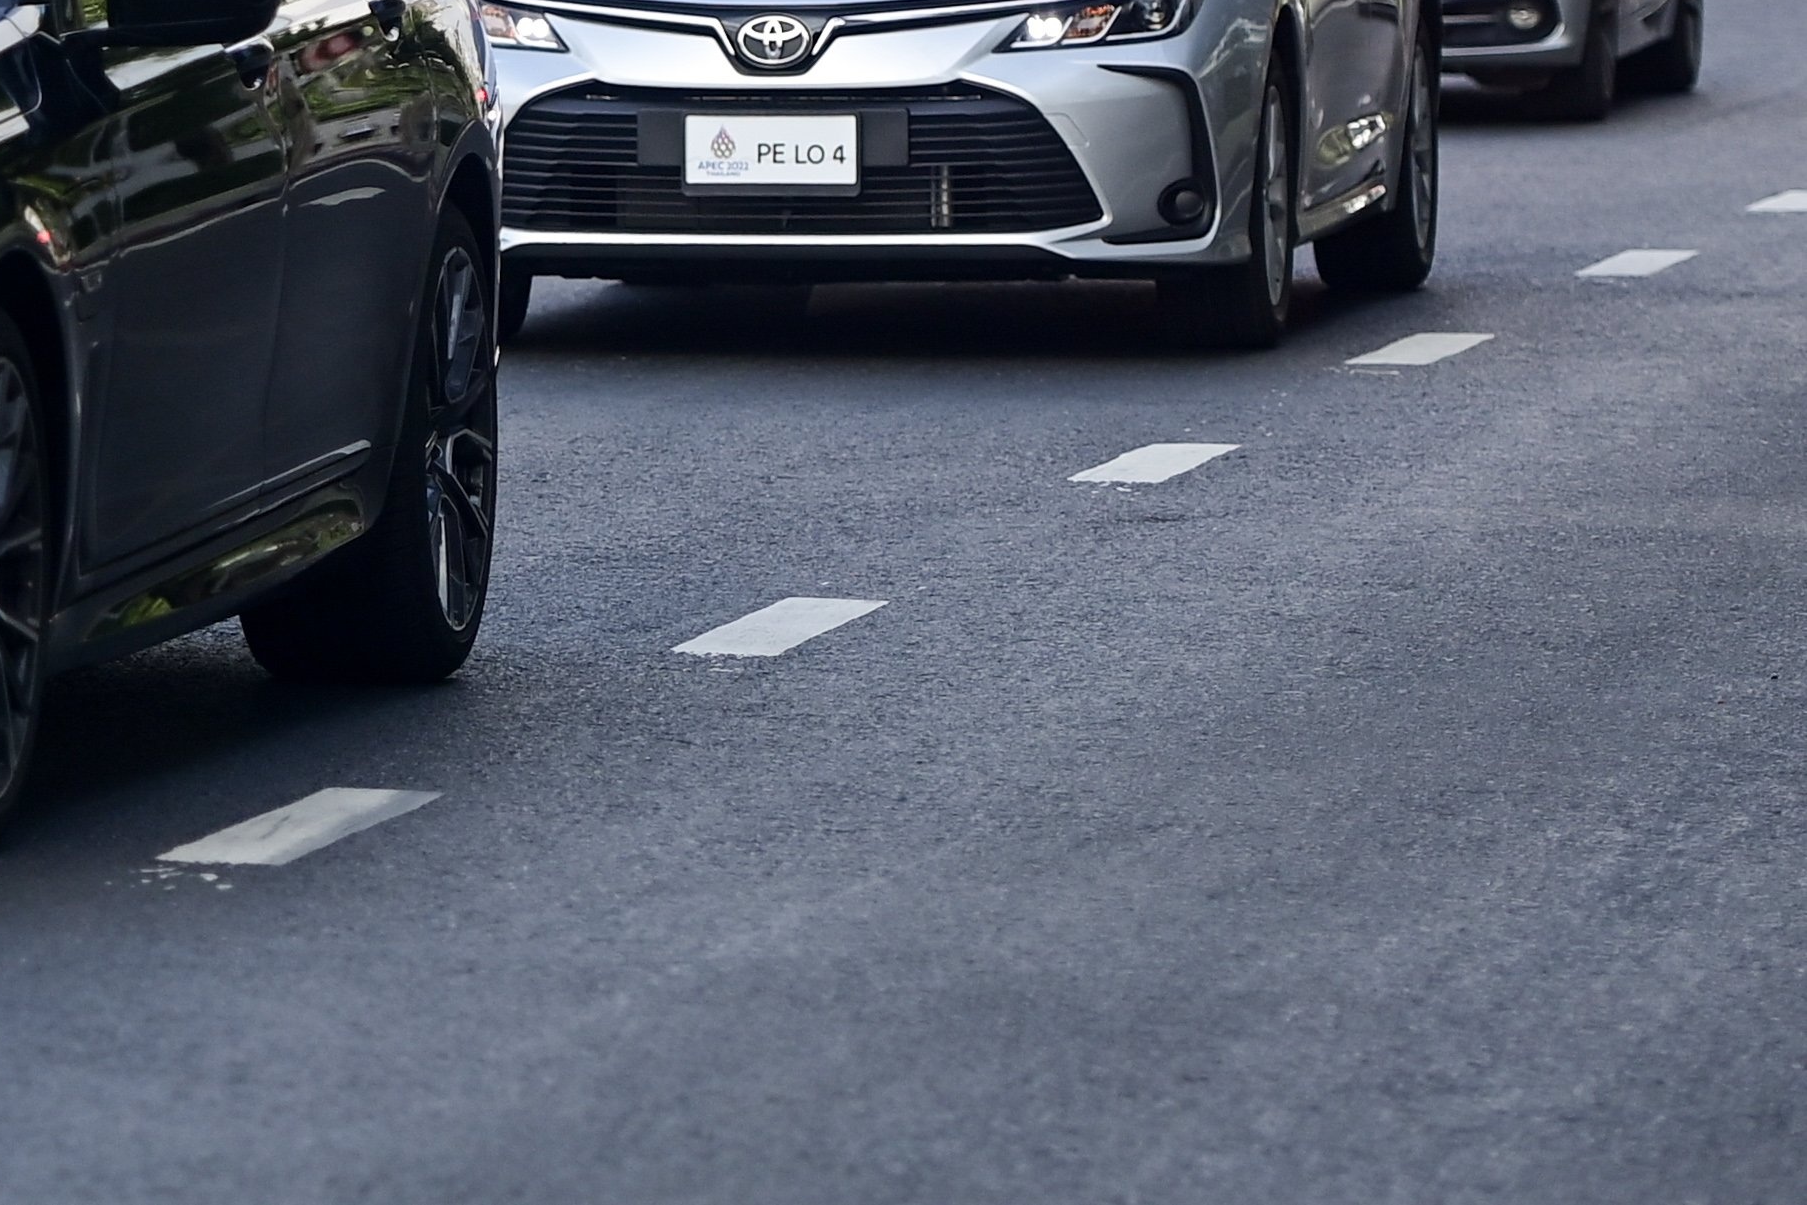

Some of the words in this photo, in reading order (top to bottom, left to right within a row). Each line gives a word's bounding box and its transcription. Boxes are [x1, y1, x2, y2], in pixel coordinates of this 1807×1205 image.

[757, 143, 786, 164] PE
[794, 144, 825, 165] LO
[832, 145, 846, 164] 4
[697, 160, 726, 172] APEC
[727, 160, 750, 172] 2022
